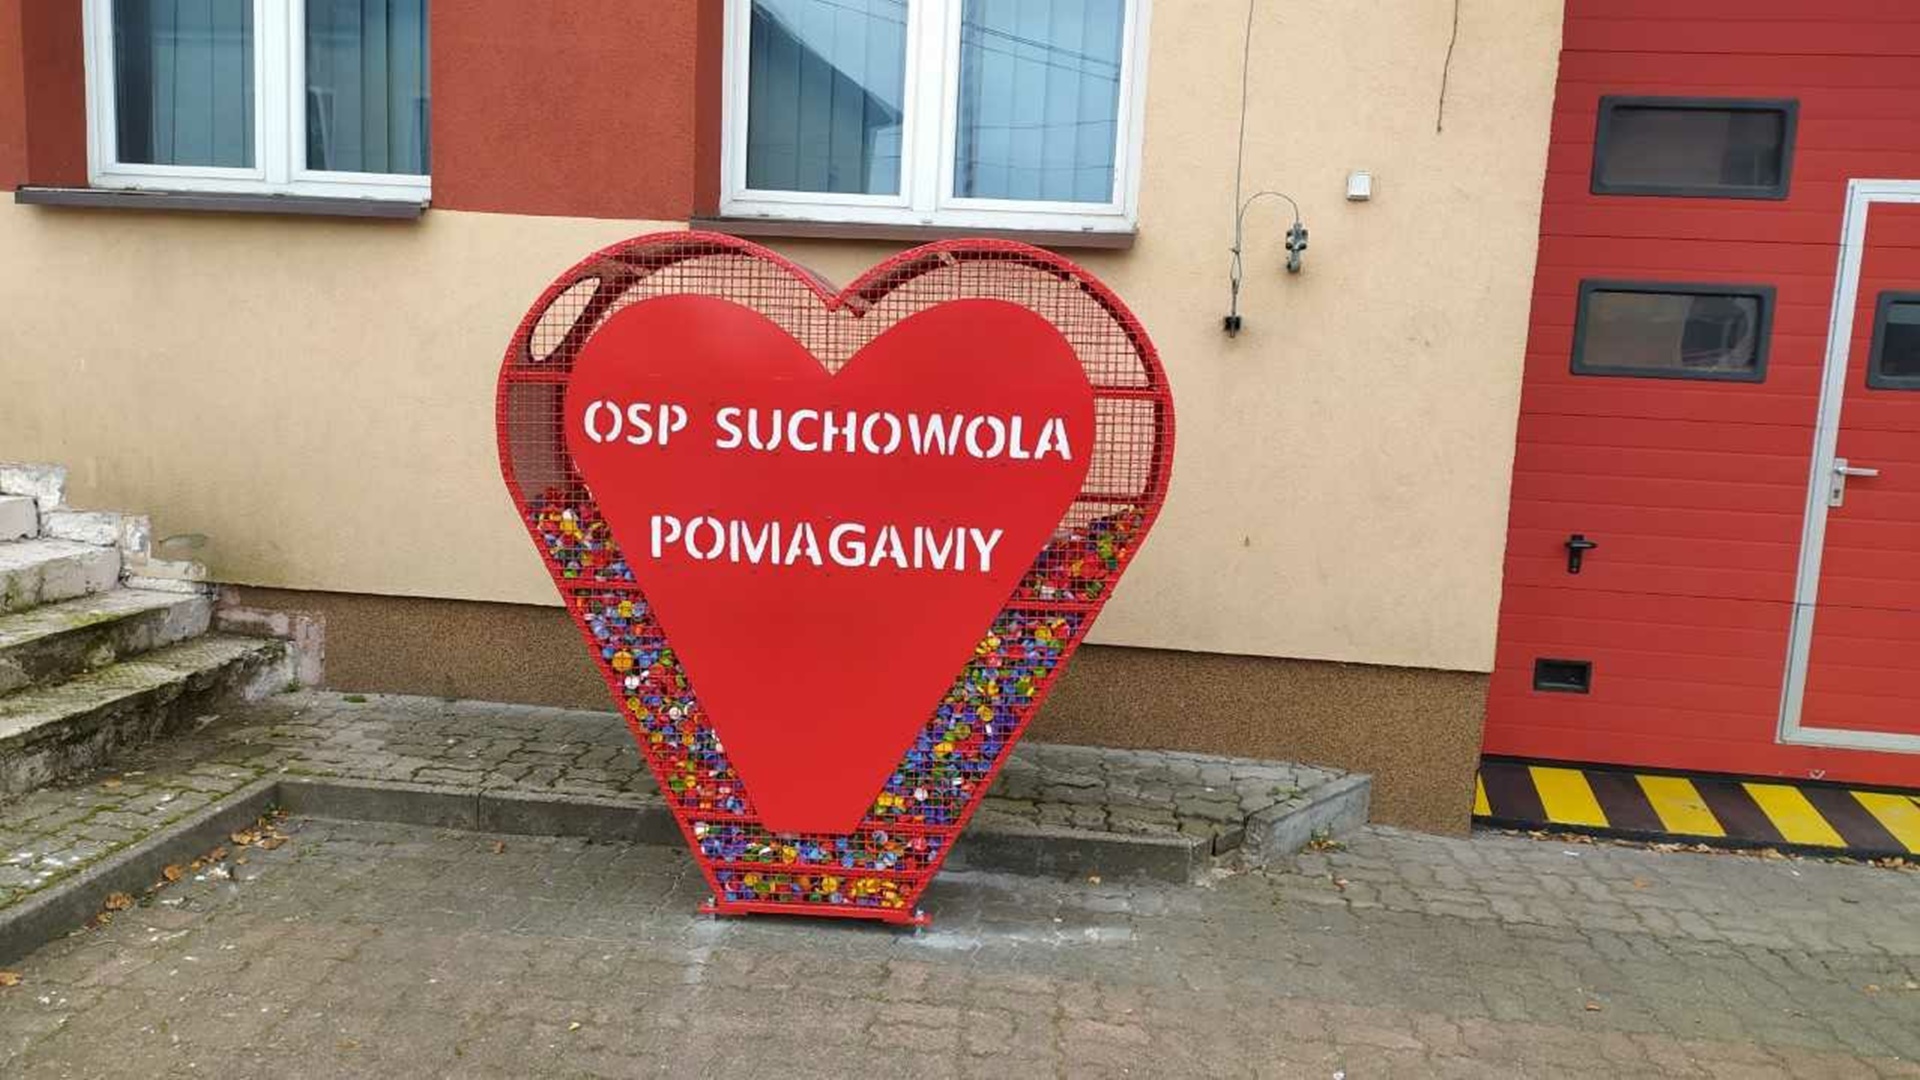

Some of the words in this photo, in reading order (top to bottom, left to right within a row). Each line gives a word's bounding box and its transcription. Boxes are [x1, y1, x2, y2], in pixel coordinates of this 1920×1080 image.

[584, 400, 688, 446] OSP
[716, 407, 1073, 461] SUCHOWOLA
[650, 515, 1004, 573] POMAGAMY
